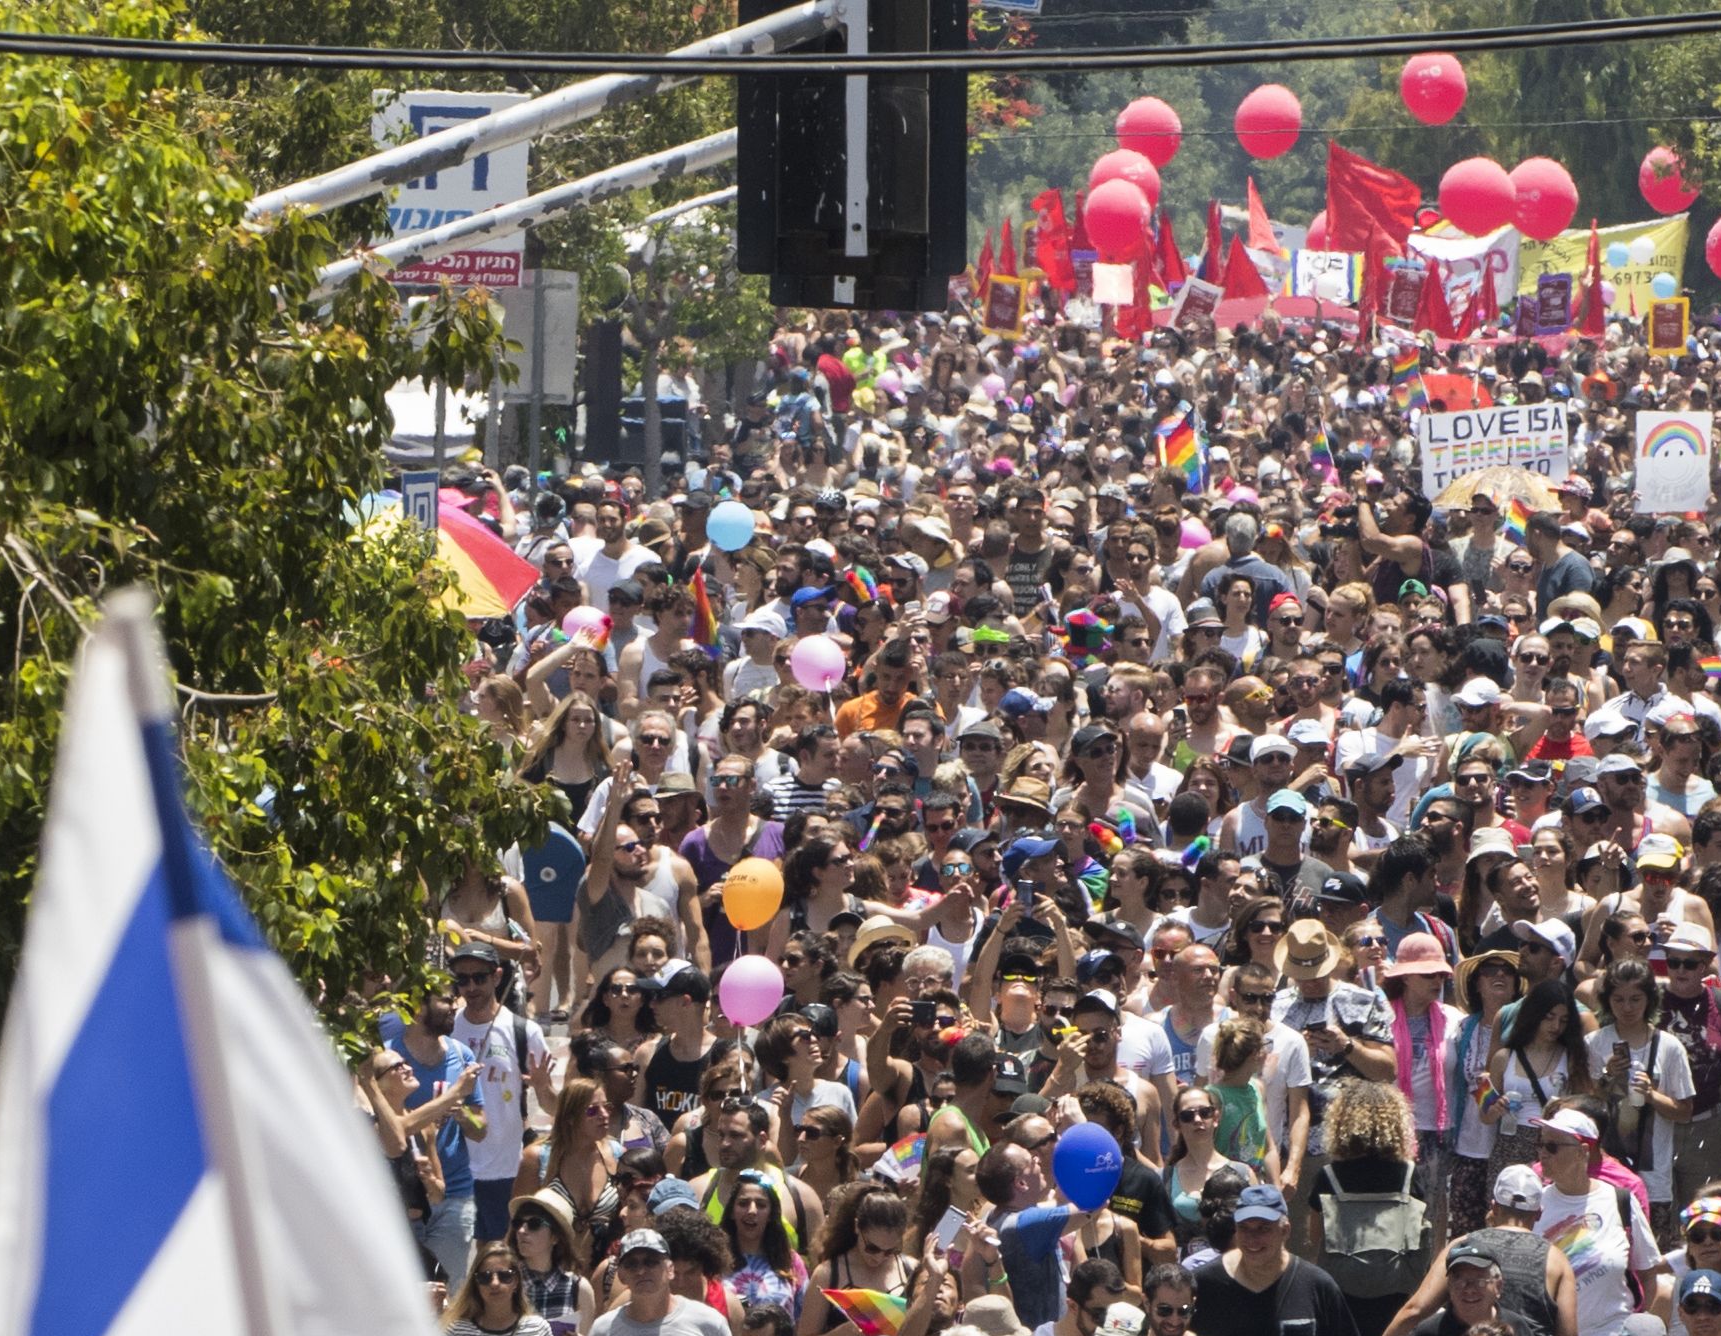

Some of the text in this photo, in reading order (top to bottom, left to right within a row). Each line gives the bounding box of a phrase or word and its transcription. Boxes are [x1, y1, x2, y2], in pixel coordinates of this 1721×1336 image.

[475, 256, 516, 271] חניון
[1428, 410, 1519, 443] LOVE
[1430, 434, 1564, 468] TERRIBLE
